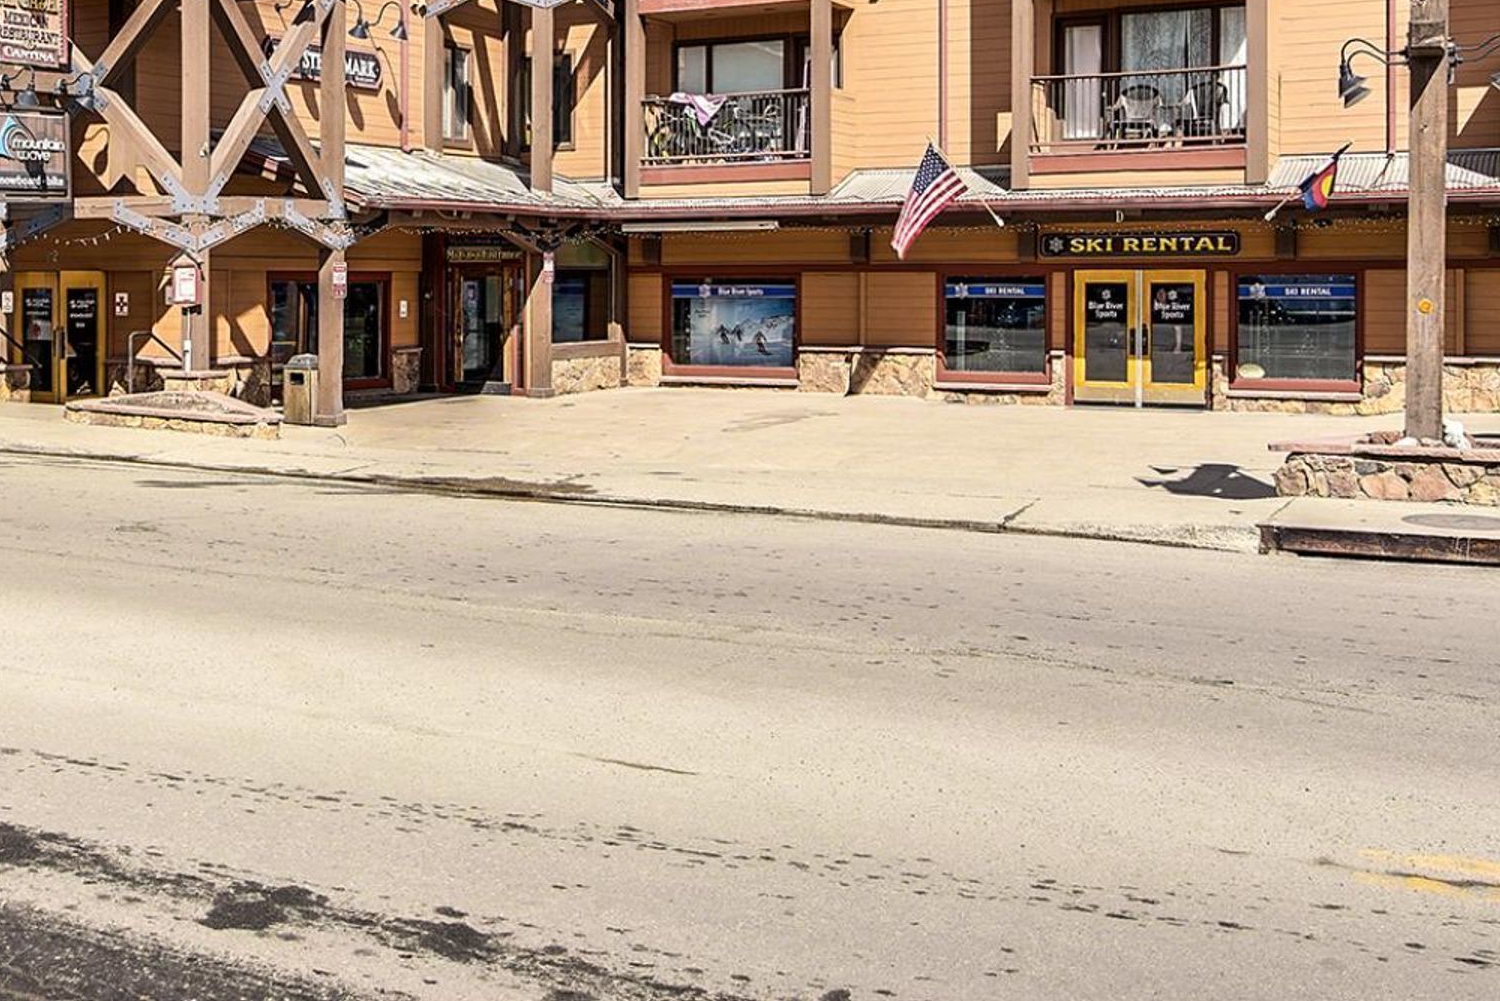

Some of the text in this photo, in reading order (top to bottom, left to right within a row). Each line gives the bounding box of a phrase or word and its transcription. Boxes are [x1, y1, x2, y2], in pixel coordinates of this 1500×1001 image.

[3, 11, 48, 28] MEXICAN
[2, 45, 55, 61] CANTINA
[12, 138, 66, 150] mountain
[17, 151, 51, 161] wave
[1115, 210, 1125, 223] D
[1070, 237, 1232, 252] SKI RENTAL
[999, 287, 1024, 295] RENTAL
[1285, 287, 1331, 296] SKI RENTAL
[1088, 301, 1123, 310] Blue River
[1172, 301, 1191, 311] River
[1095, 310, 1117, 319] Sports
[1161, 310, 1184, 320] Sports
